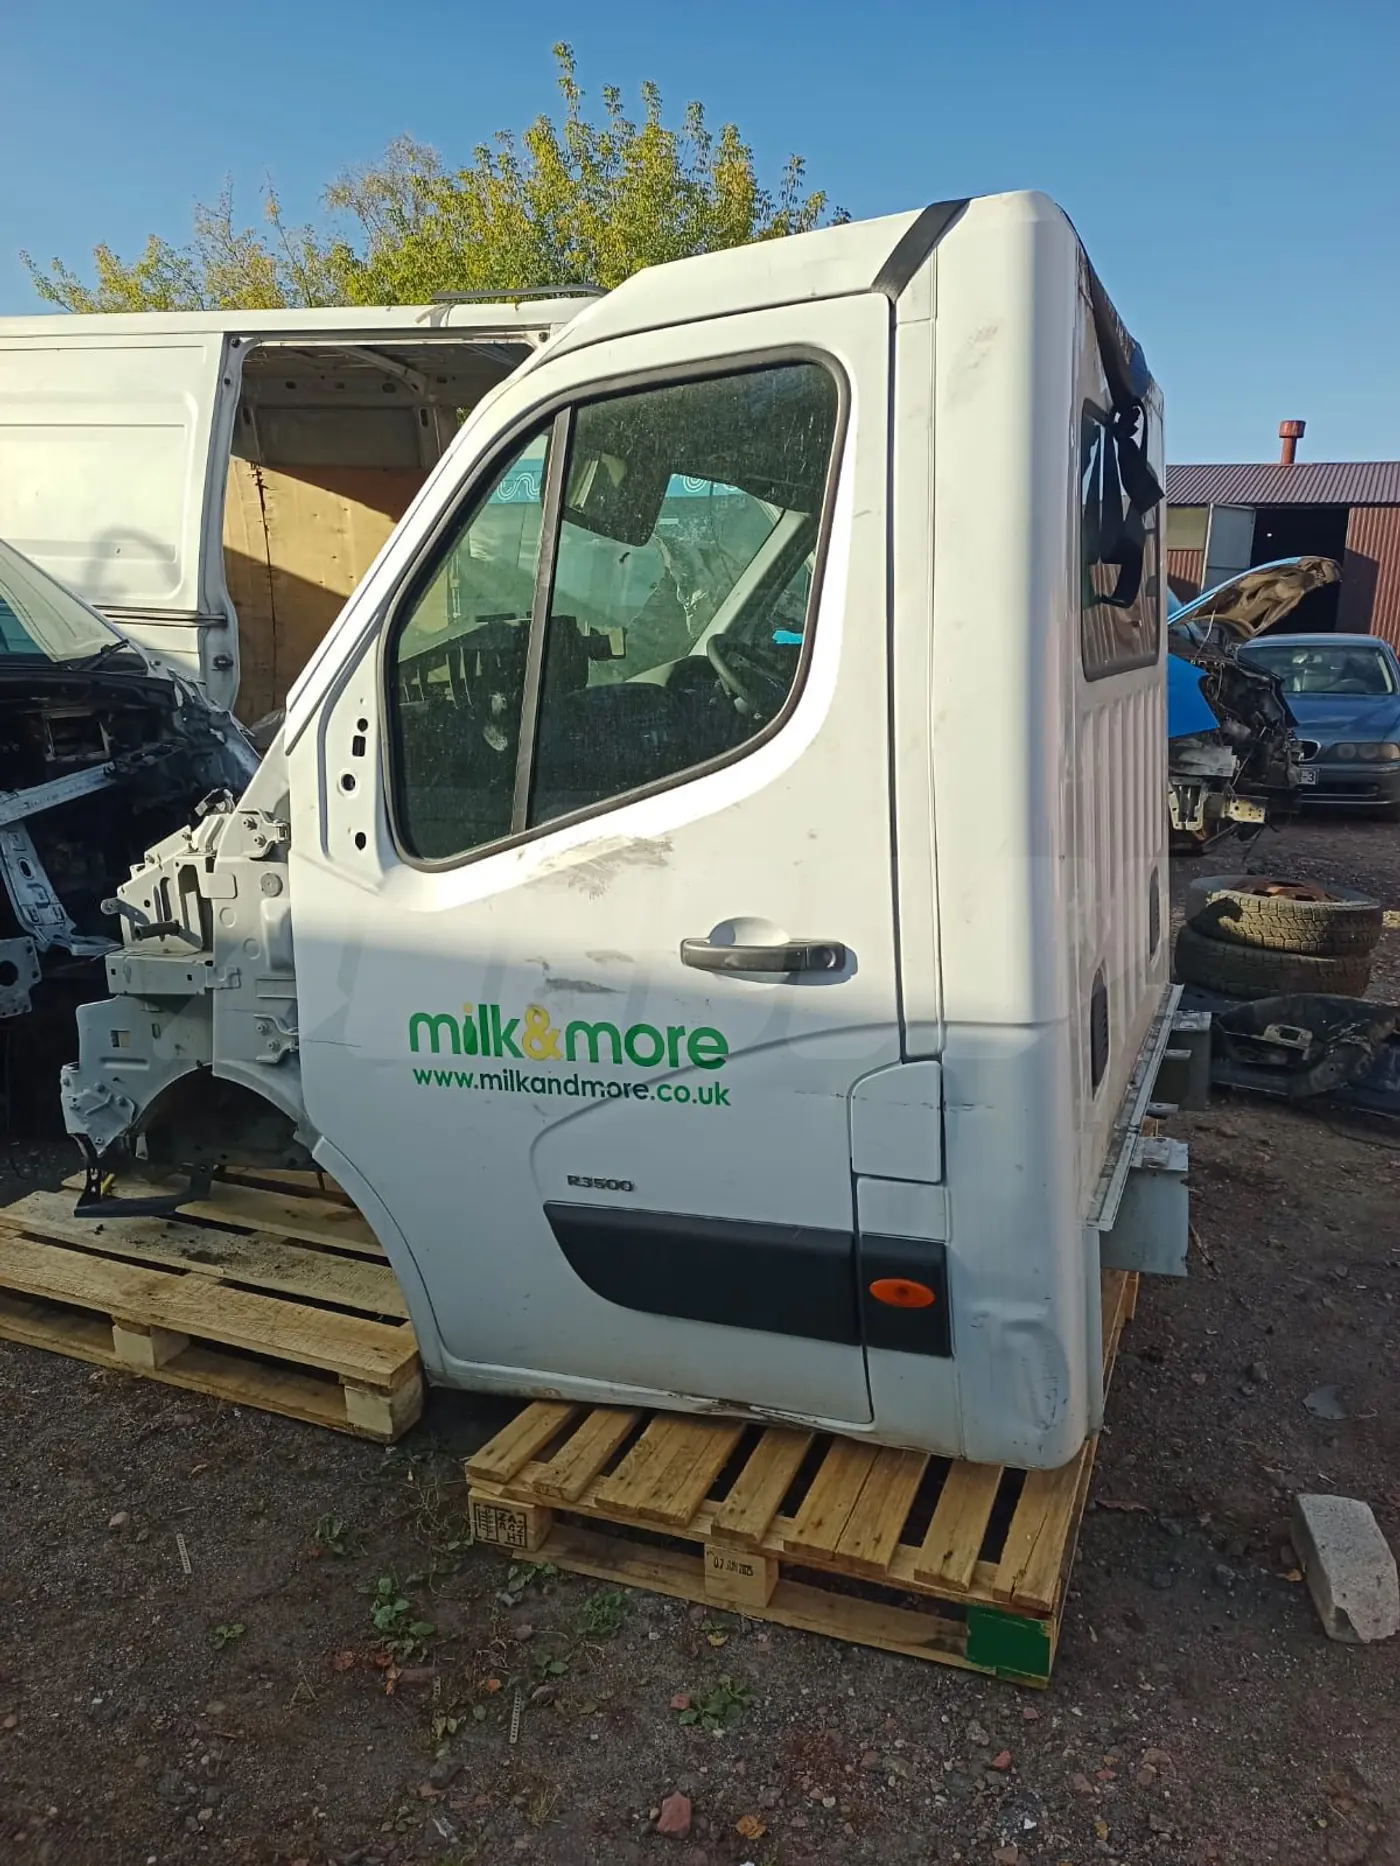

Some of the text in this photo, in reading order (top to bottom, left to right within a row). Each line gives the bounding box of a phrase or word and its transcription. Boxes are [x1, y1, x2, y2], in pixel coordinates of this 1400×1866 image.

[409, 1002, 729, 1070] milk&more
[413, 1068, 731, 1106] www.milkandmore.co.uk
[566, 1174, 634, 1192] R3500
